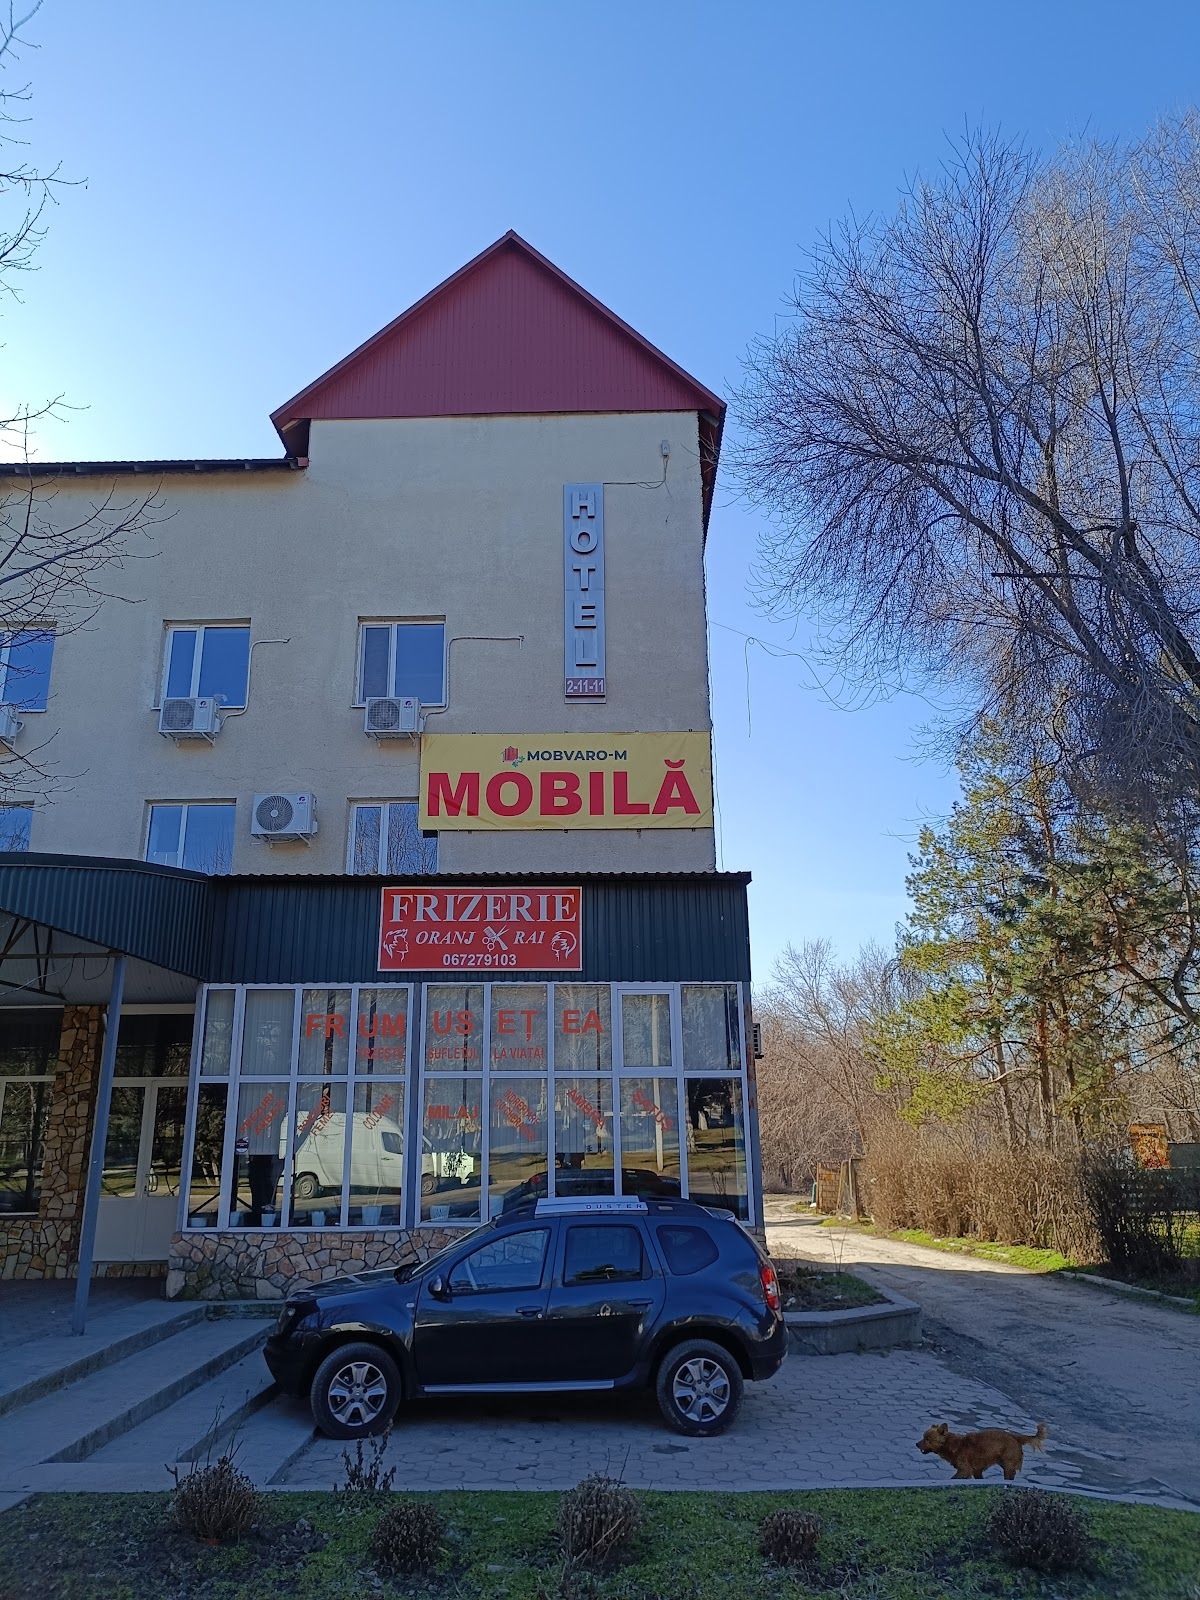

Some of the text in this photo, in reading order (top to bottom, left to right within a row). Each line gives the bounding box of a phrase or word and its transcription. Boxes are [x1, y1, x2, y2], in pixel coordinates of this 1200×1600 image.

[570, 491, 598, 666] HOTEL
[566, 679, 604, 693] 2-11-11
[527, 749, 627, 761] MOBVARO-M
[427, 759, 701, 816] MOBILĂ
[389, 894, 577, 922] FRIZERIE
[415, 930, 546, 945] ORANJ RAI
[442, 953, 517, 966] 067279103
